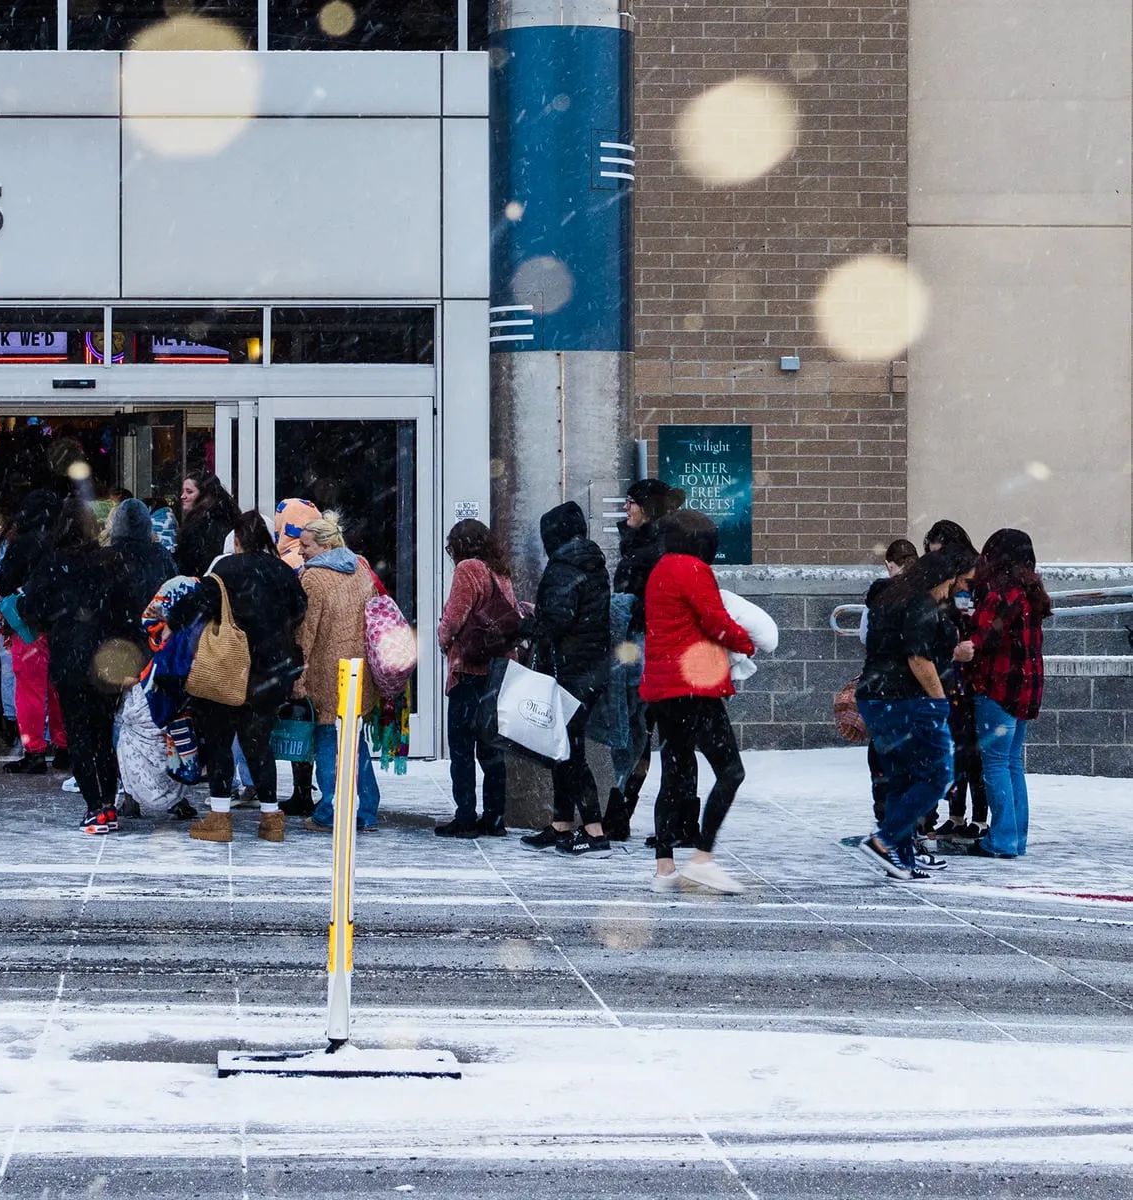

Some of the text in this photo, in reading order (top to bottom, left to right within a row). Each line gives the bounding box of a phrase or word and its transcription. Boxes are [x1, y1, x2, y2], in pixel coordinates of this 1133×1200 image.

[20, 331, 55, 346] WE'D
[689, 439, 731, 455] twilight
[684, 462, 728, 474] ENTER
[679, 474, 731, 486] TO WIN
[691, 486, 721, 498] FREE
[679, 498, 735, 510] ICKETS!
